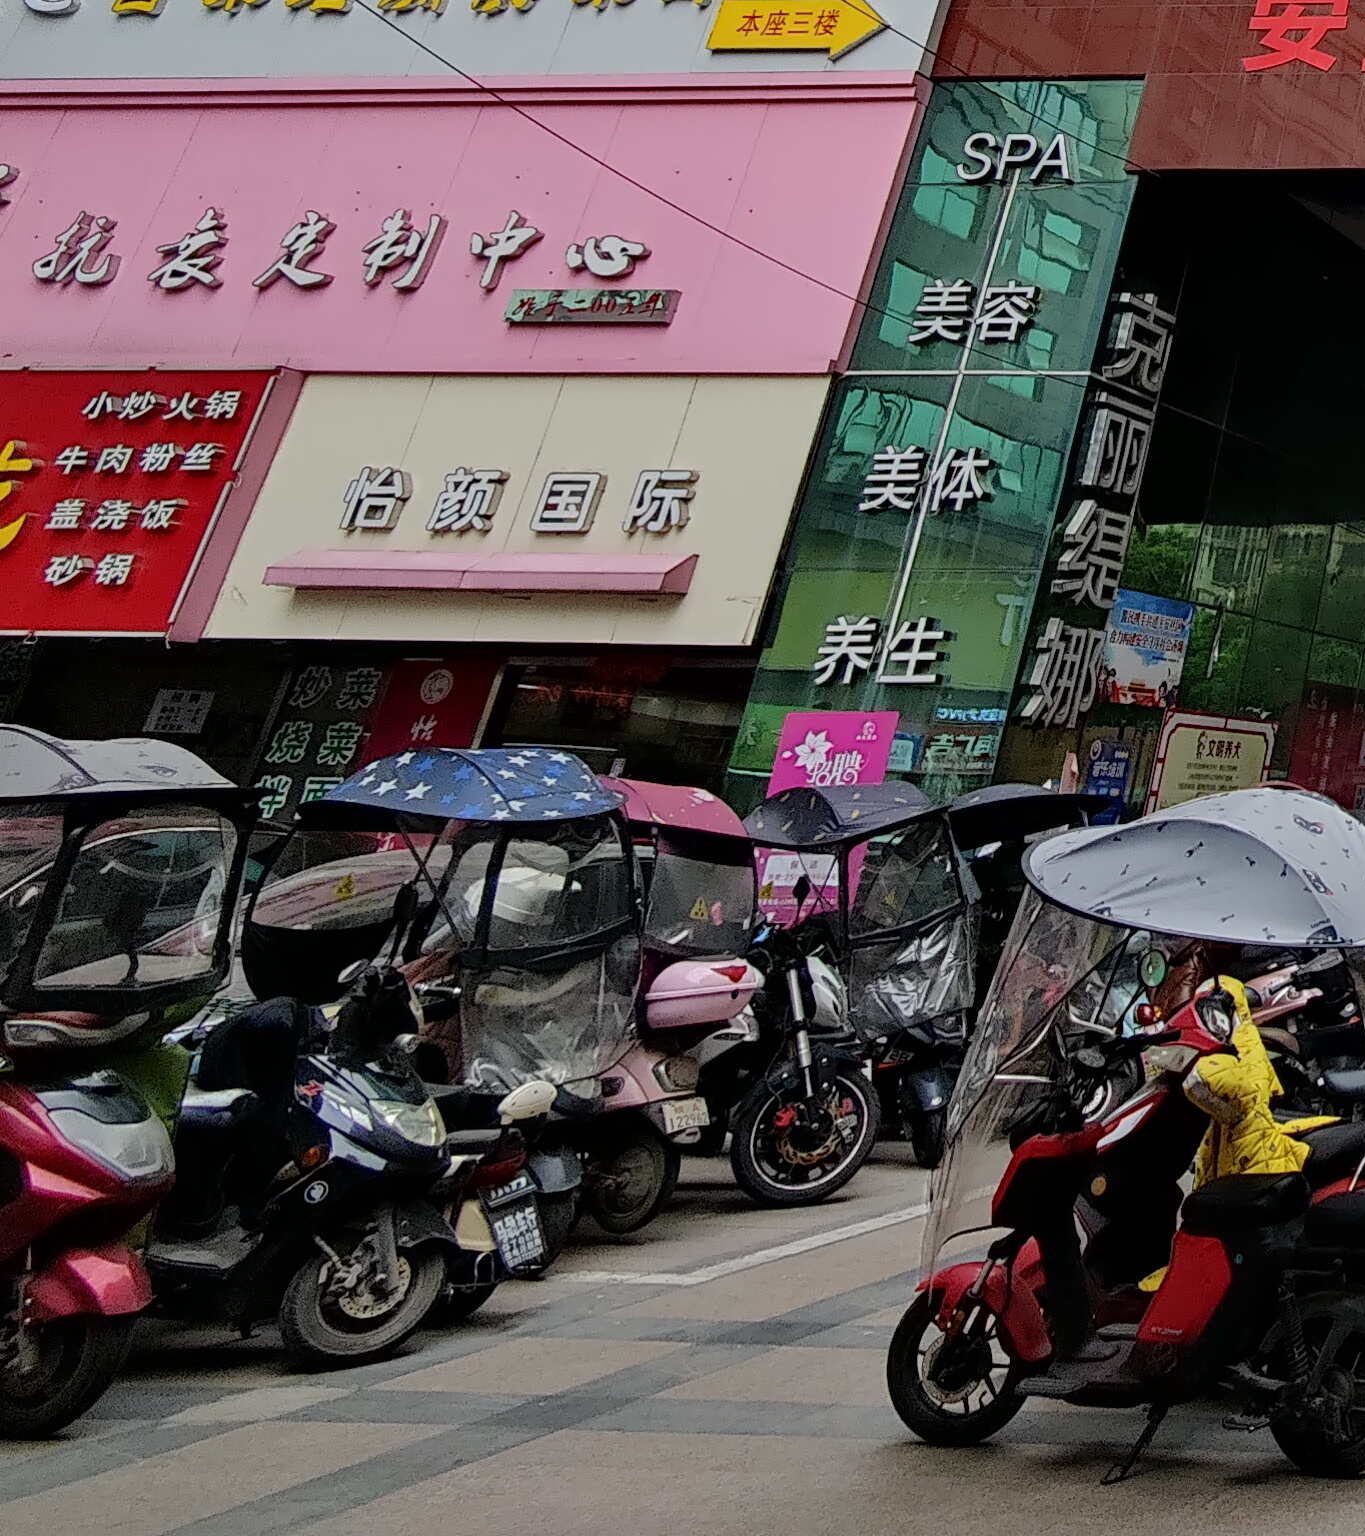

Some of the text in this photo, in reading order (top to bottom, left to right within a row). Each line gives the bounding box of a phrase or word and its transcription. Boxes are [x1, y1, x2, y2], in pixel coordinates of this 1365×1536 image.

[736, 10, 838, 38] 本座三楼
[955, 133, 1071, 181] SPA
[909, 280, 1038, 344] 美容
[82, 390, 241, 420] 小炒火锅
[54, 443, 217, 474] 牛肉粉丝
[859, 447, 989, 513] 美体
[44, 498, 176, 530] 盖浇饭
[341, 468, 693, 534] 怡颜国际
[1020, 290, 1176, 730] 克丽缇娜
[44, 553, 134, 586] 砂锅
[813, 616, 946, 685] 养生
[291, 666, 381, 709] 炒菜
[265, 721, 364, 765] 烧菜
